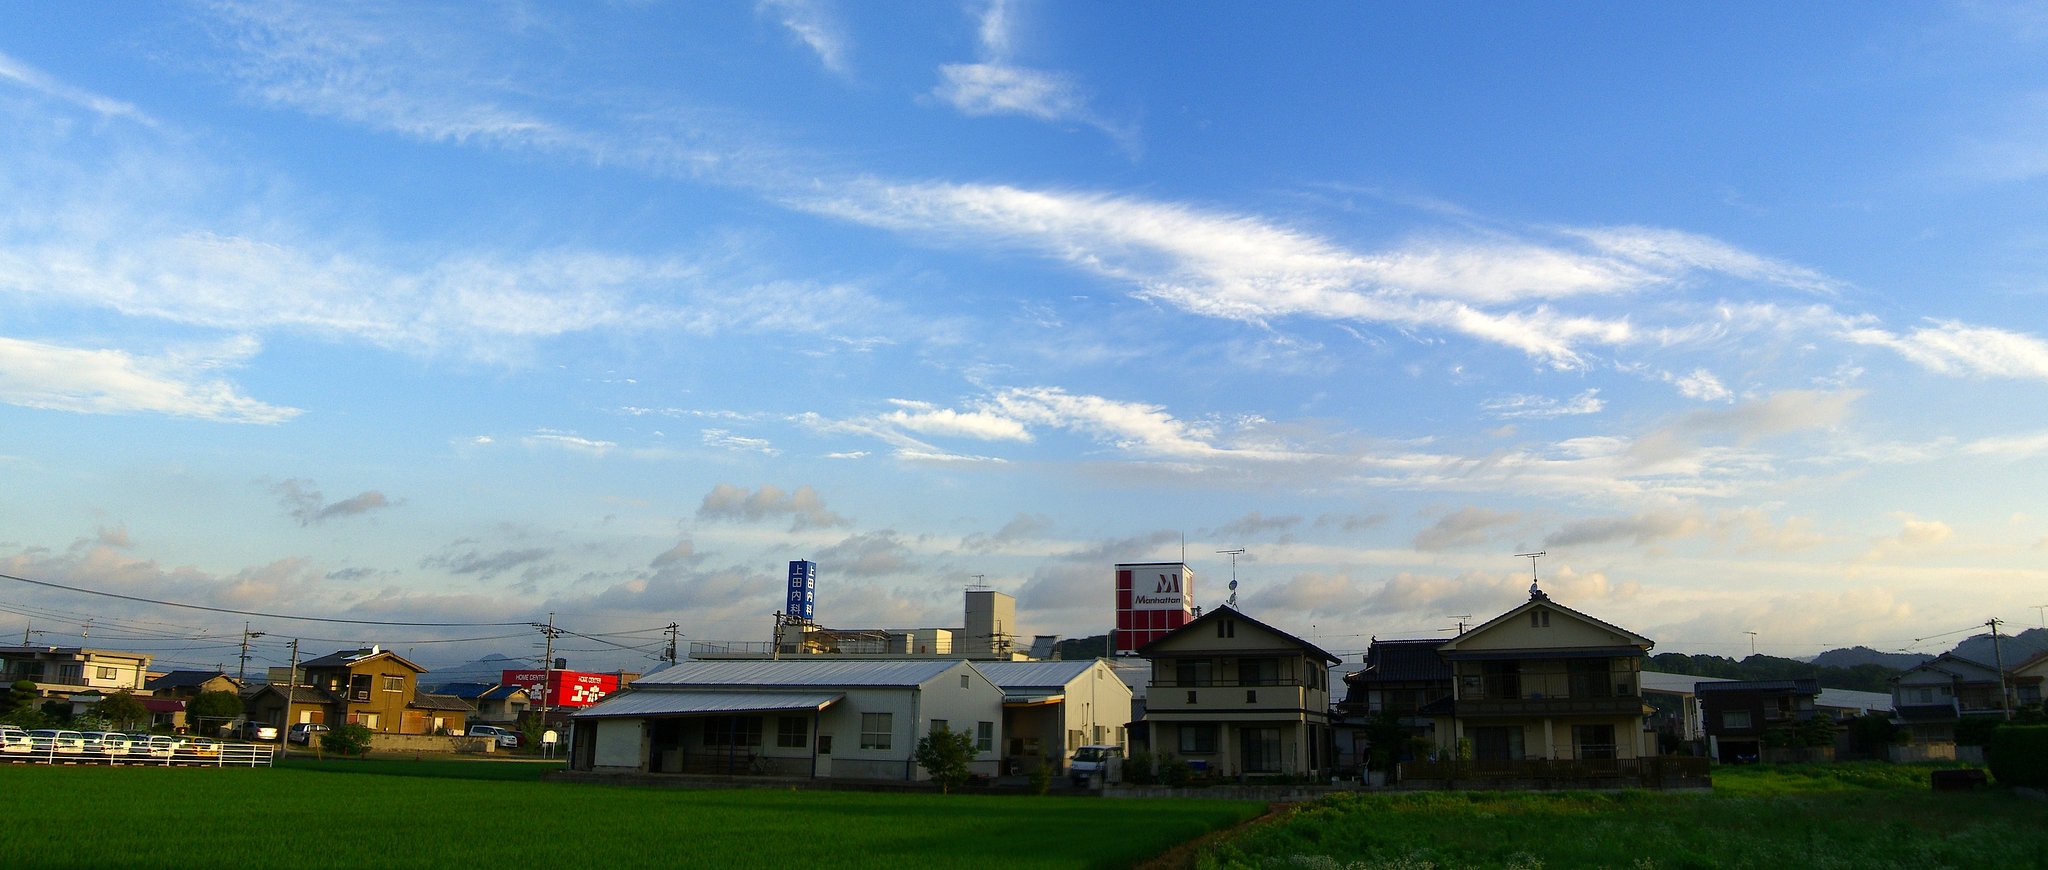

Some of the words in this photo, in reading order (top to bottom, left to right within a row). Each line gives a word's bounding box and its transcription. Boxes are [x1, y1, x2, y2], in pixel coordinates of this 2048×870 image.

[790, 564, 803, 614] 上田内科
[806, 565, 815, 616] 上田内科
[1135, 595, 1181, 604] Manhattan
